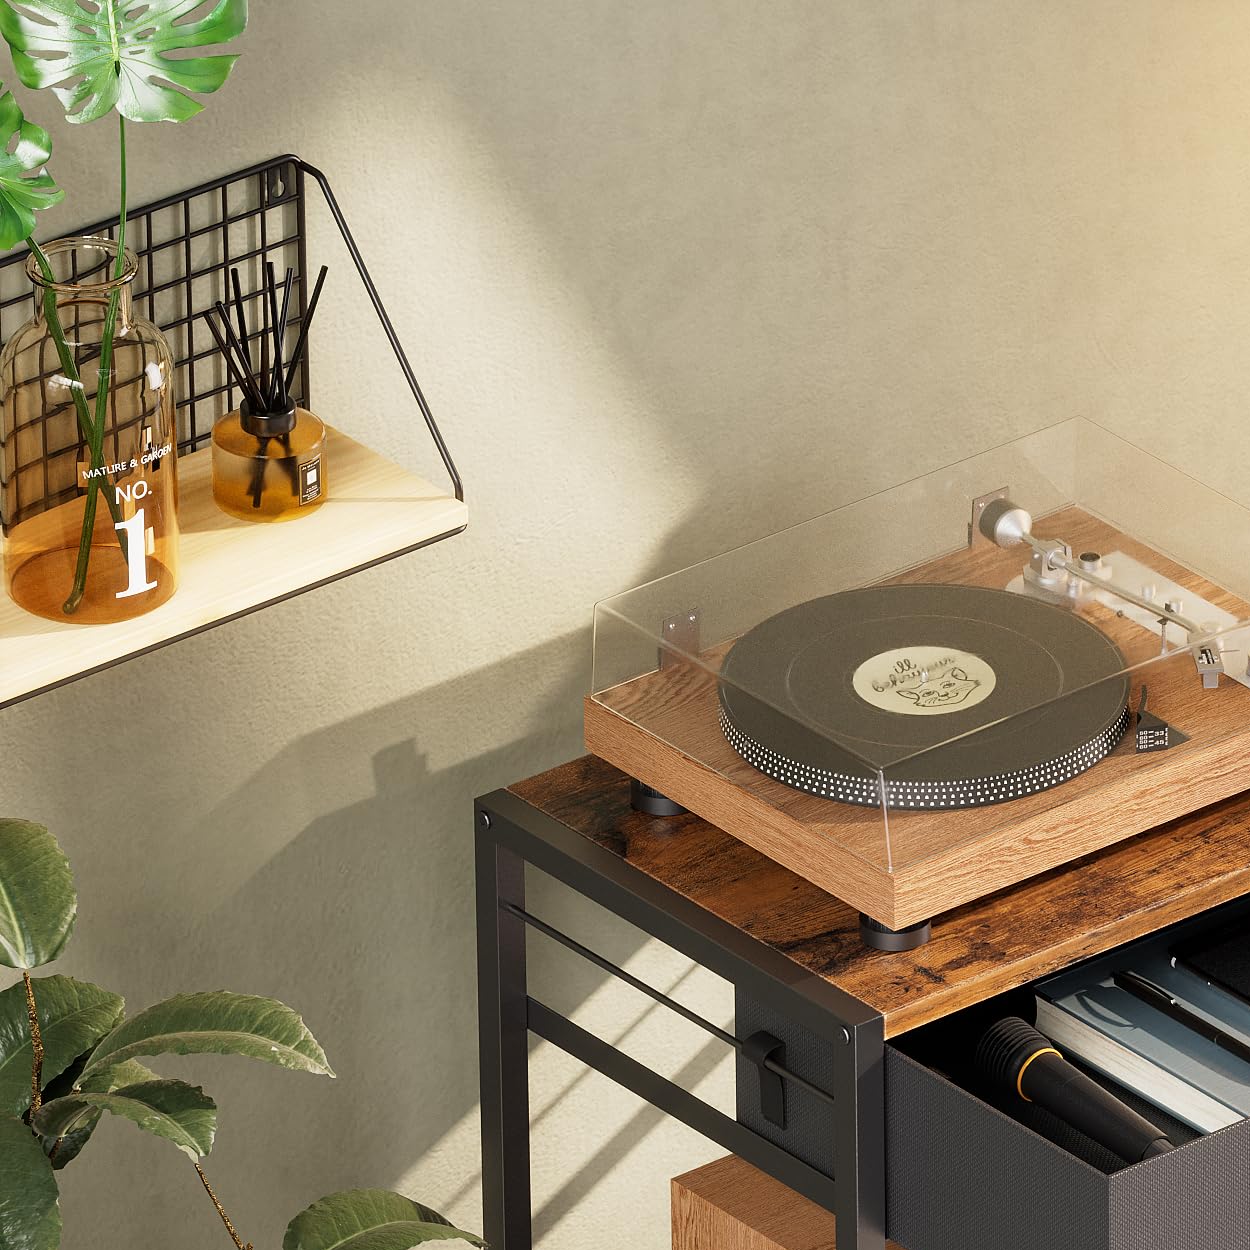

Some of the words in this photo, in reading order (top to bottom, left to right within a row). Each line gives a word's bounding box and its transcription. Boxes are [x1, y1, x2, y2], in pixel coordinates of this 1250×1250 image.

[130, 459, 138, 468] &
[115, 480, 152, 504] NO.
[114, 508, 158, 598] 1
